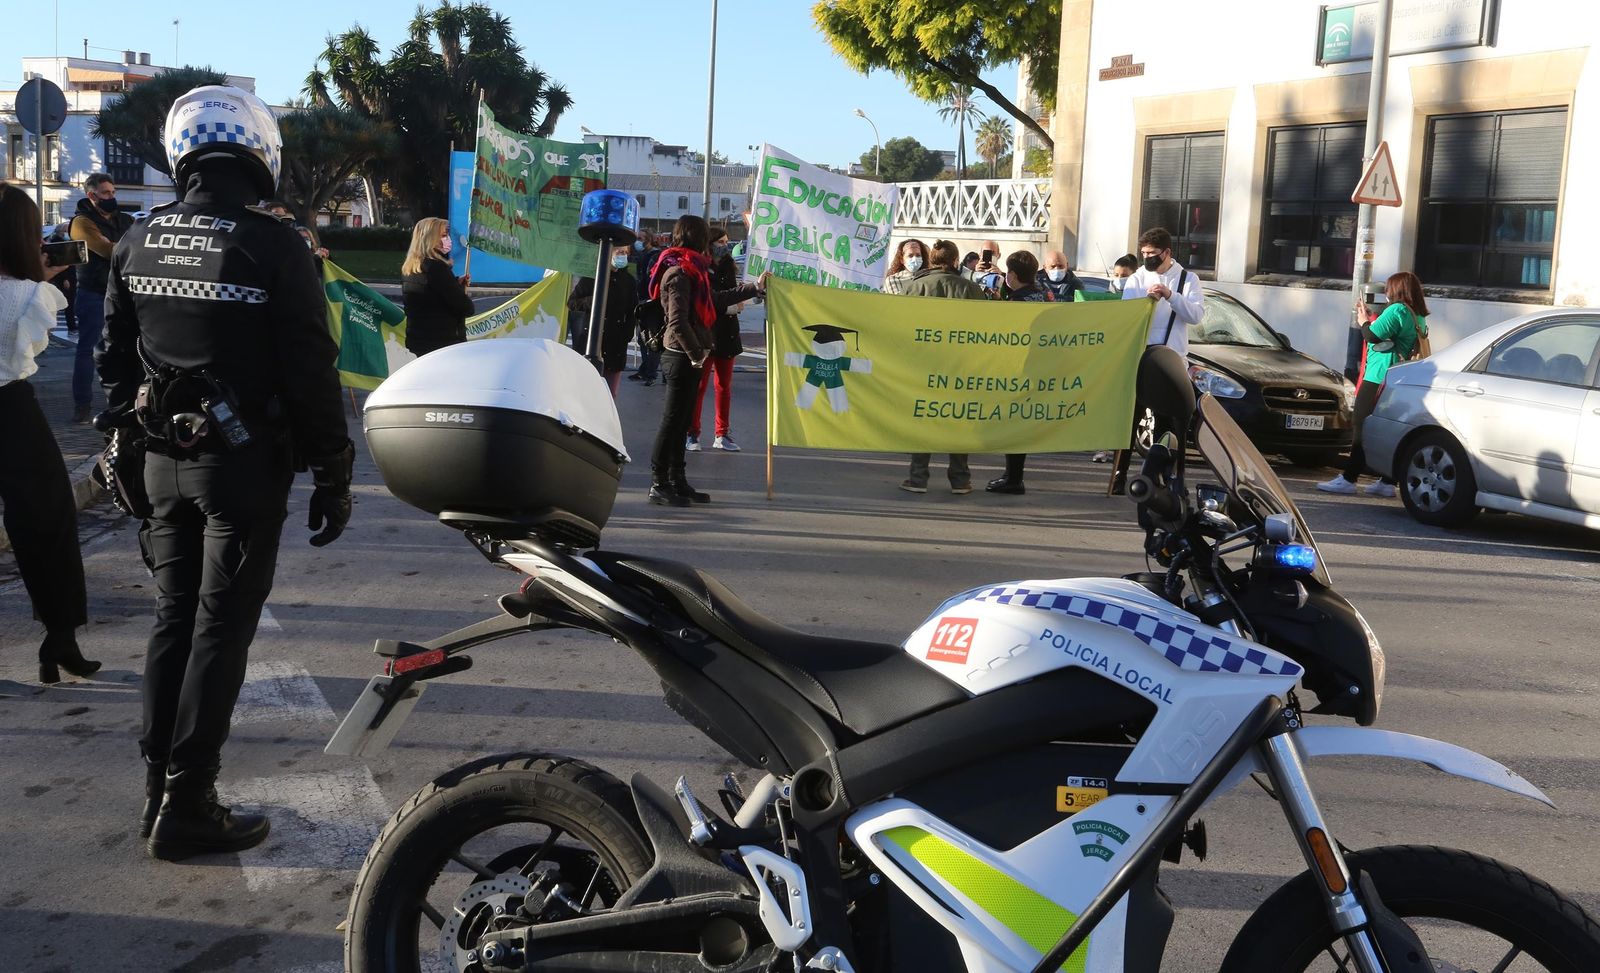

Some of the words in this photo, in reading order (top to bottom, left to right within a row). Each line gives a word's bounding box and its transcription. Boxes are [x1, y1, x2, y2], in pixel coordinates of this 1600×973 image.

[182, 105, 196, 117] PL
[199, 102, 237, 113] JEREZ
[760, 155, 894, 225] EDUCACIÓN
[147, 213, 237, 233] POLICIA
[751, 201, 851, 265] PÚBLICA
[144, 233, 222, 252] LOCAL
[158, 254, 202, 266] JEREZ
[466, 320, 491, 336] NANDO
[490, 305, 520, 329] SAVATER
[914, 329, 942, 343] IES
[949, 331, 1031, 346] FERNANDO
[1038, 332, 1105, 347] SAVATER
[816, 362, 838, 371] ESCUELA
[928, 374, 948, 389] EN
[954, 376, 1030, 392] DEFENSA
[1037, 378, 1056, 391] DE
[1062, 376, 1082, 391] LA
[425, 411, 474, 423] SH45
[913, 399, 1001, 421] ESCUELA
[1009, 397, 1087, 421] PÚBLICA
[1292, 417, 1309, 427] 2679
[936, 622, 974, 648] 112
[1039, 628, 1109, 672] POLICIA
[1112, 662, 1174, 705] LOCAL
[1065, 793, 1075, 806] 5
[1075, 793, 1100, 802] YEAR
[1076, 823, 1103, 831] POLICIA
[1103, 825, 1124, 839] LOCAL
[1086, 847, 1109, 858] JEREZ
